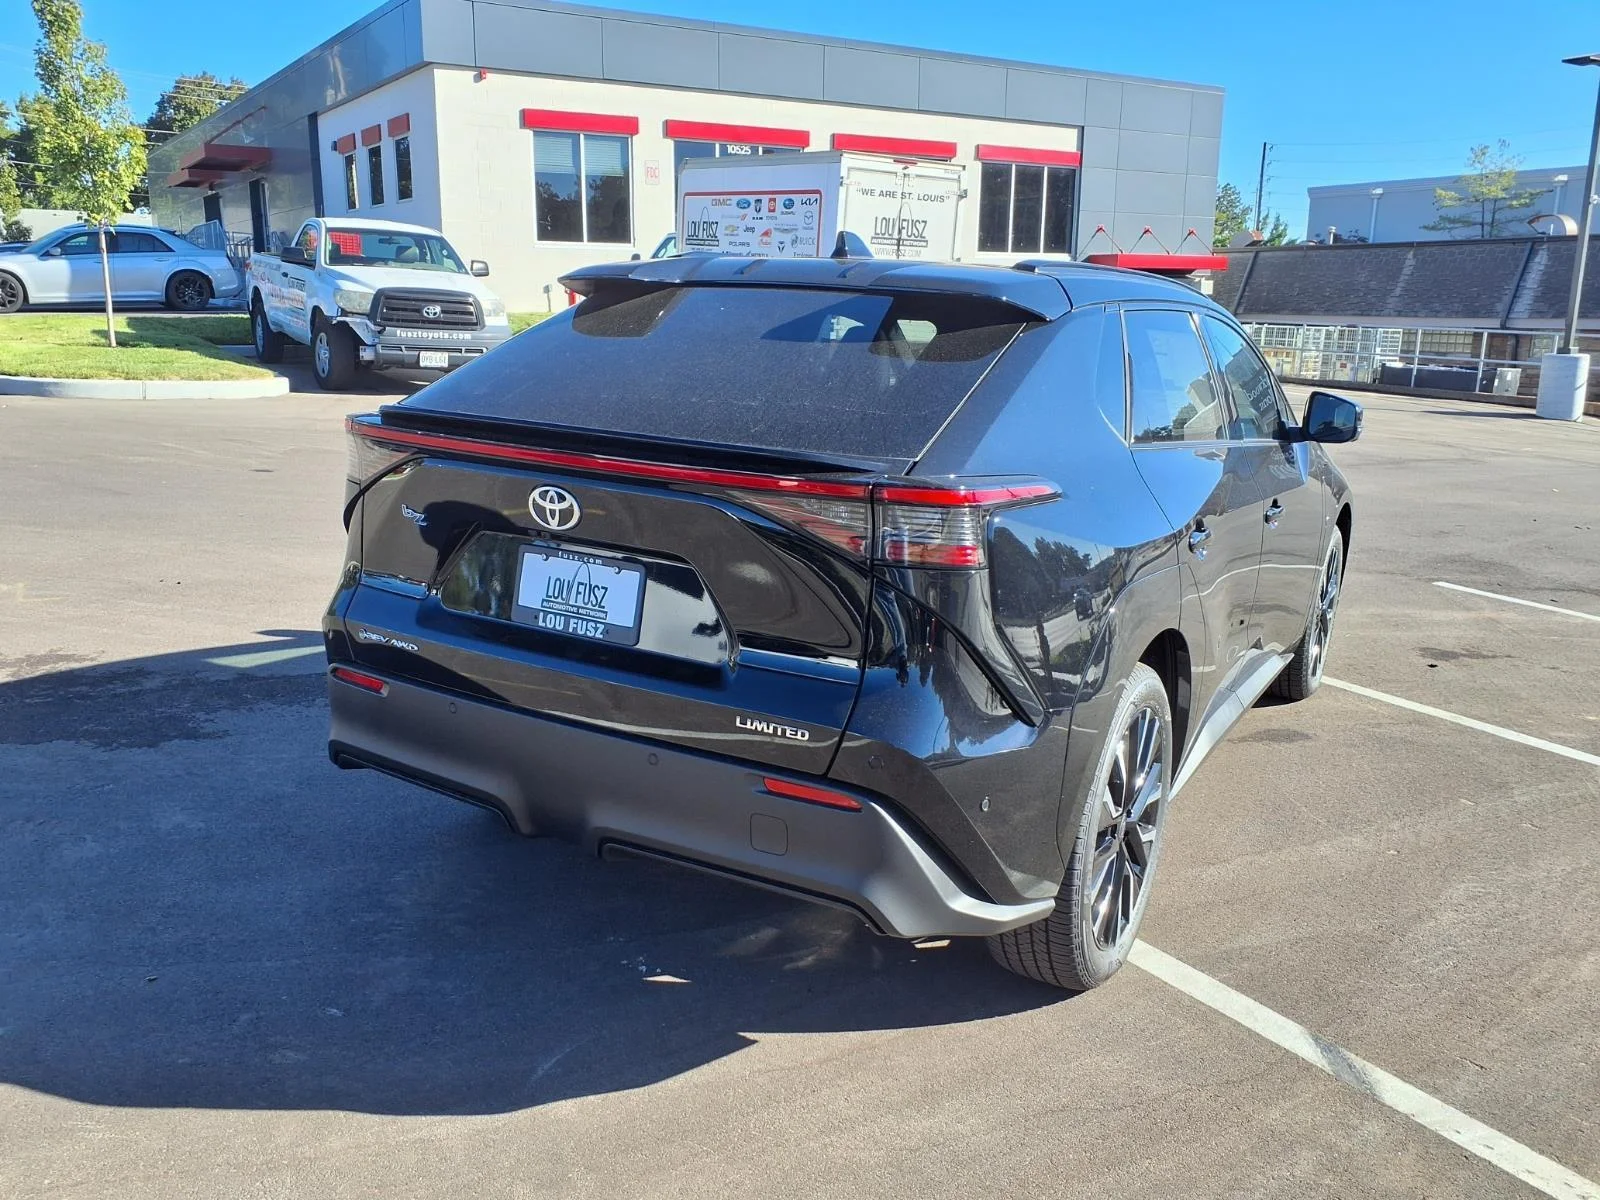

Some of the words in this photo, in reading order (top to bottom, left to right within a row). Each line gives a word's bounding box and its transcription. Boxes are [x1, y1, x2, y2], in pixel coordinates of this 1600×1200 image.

[726, 145, 751, 155] 10525
[878, 190, 898, 199] ARE
[900, 192, 914, 200] ST.
[711, 198, 733, 207] GMC
[801, 198, 818, 206] KIA
[687, 220, 700, 238] LOU
[702, 221, 719, 239] FUSZ
[743, 225, 756, 234] Jeep
[874, 216, 895, 237] LOU
[899, 218, 928, 239] FUSZ
[396, 329, 472, 340] fusztoyota.com
[558, 551, 603, 565] fusz.com
[545, 576, 571, 602] LOU
[574, 581, 609, 609] FUSZ
[542, 600, 579, 613] AUTOMOTIVE
[578, 606, 608, 619] NETWORK
[538, 611, 565, 630] LOU
[568, 618, 605, 638] FUSZ
[390, 639, 419, 651] AWD
[735, 715, 810, 741] LIMITED
